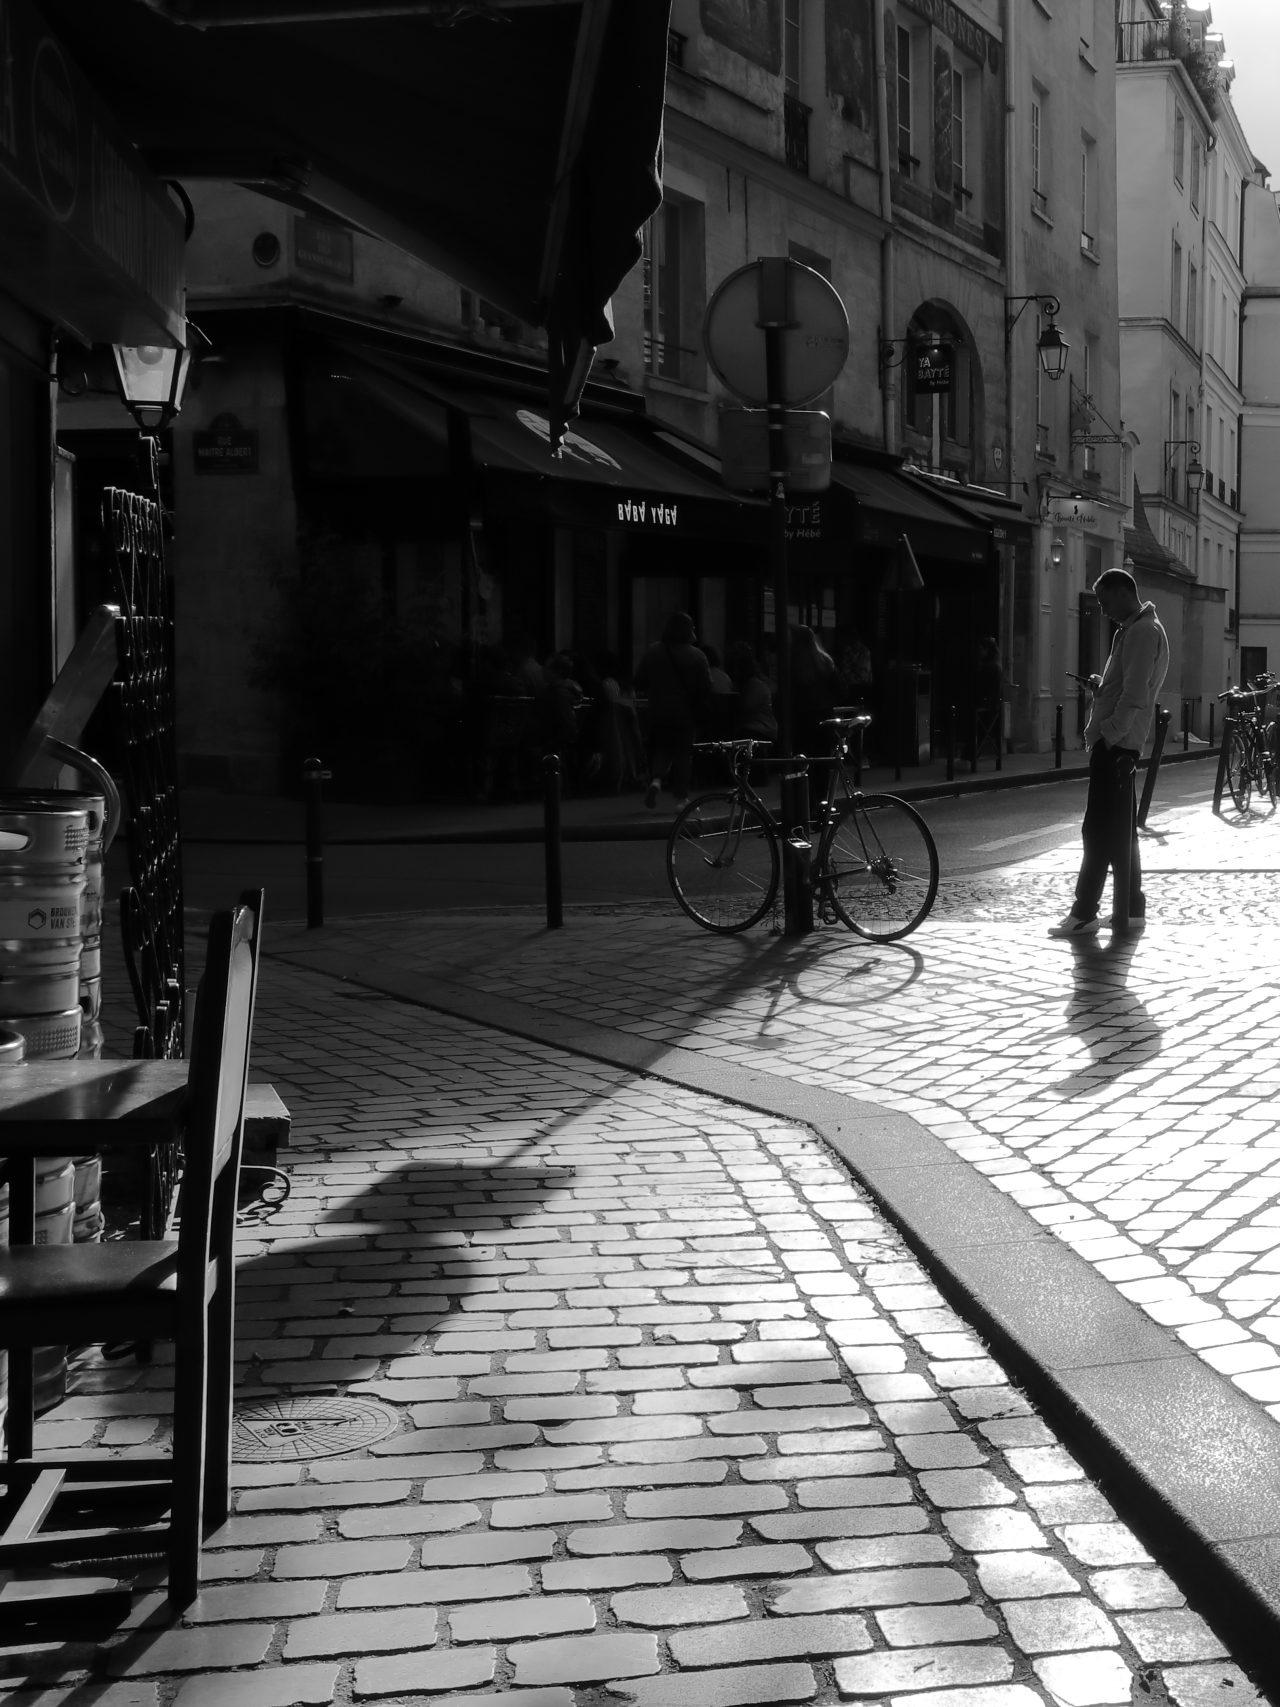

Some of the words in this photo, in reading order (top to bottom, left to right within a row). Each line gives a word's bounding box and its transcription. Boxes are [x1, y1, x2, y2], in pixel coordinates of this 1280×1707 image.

[918, 356, 931, 368] YA
[225, 446, 252, 457] ALBERT
[617, 499, 646, 523] BABA
[651, 503, 678, 527] YAGA
[796, 528, 822, 539] Hébé
[51, 918, 65, 929] VAN
